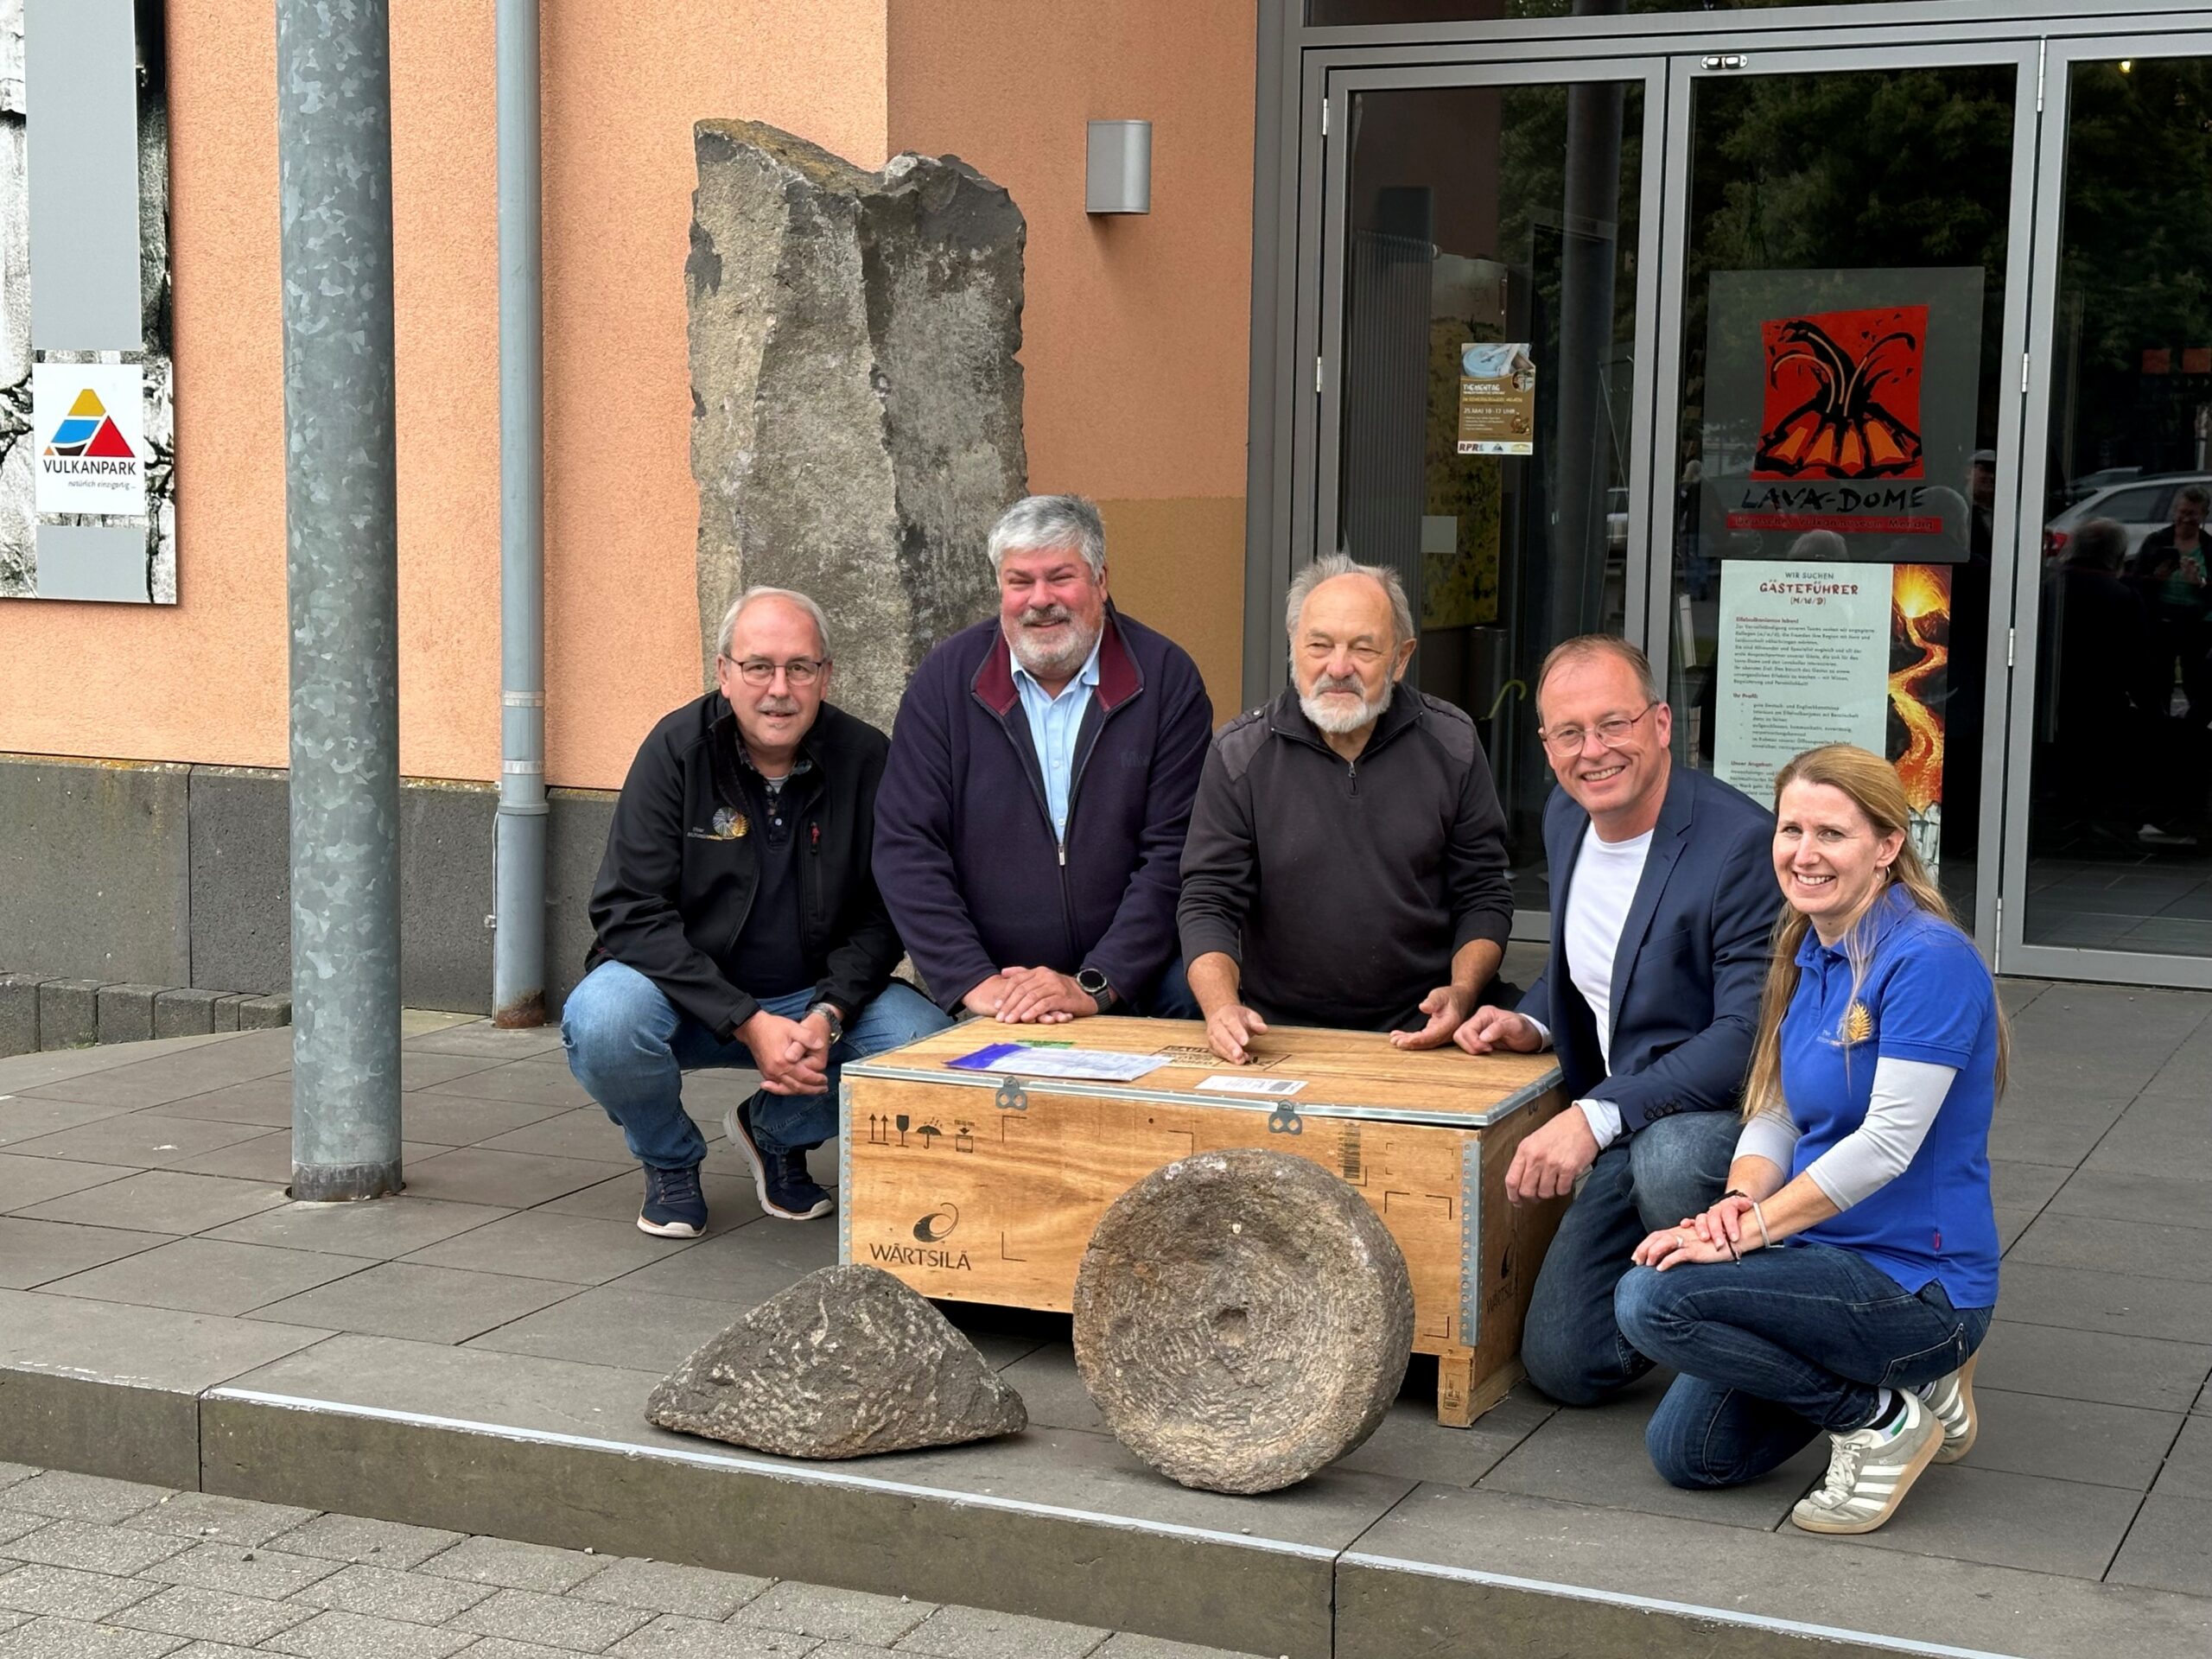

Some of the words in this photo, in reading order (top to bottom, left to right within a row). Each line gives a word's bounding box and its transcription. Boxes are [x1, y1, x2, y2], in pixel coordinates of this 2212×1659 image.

[43, 460, 137, 475] VULKANPARK
[1741, 486, 1928, 512] LAVA-DOME
[1759, 579, 1859, 594] GÄSTEFÜHRER
[868, 1243, 972, 1271] WÄRTSILÄ
